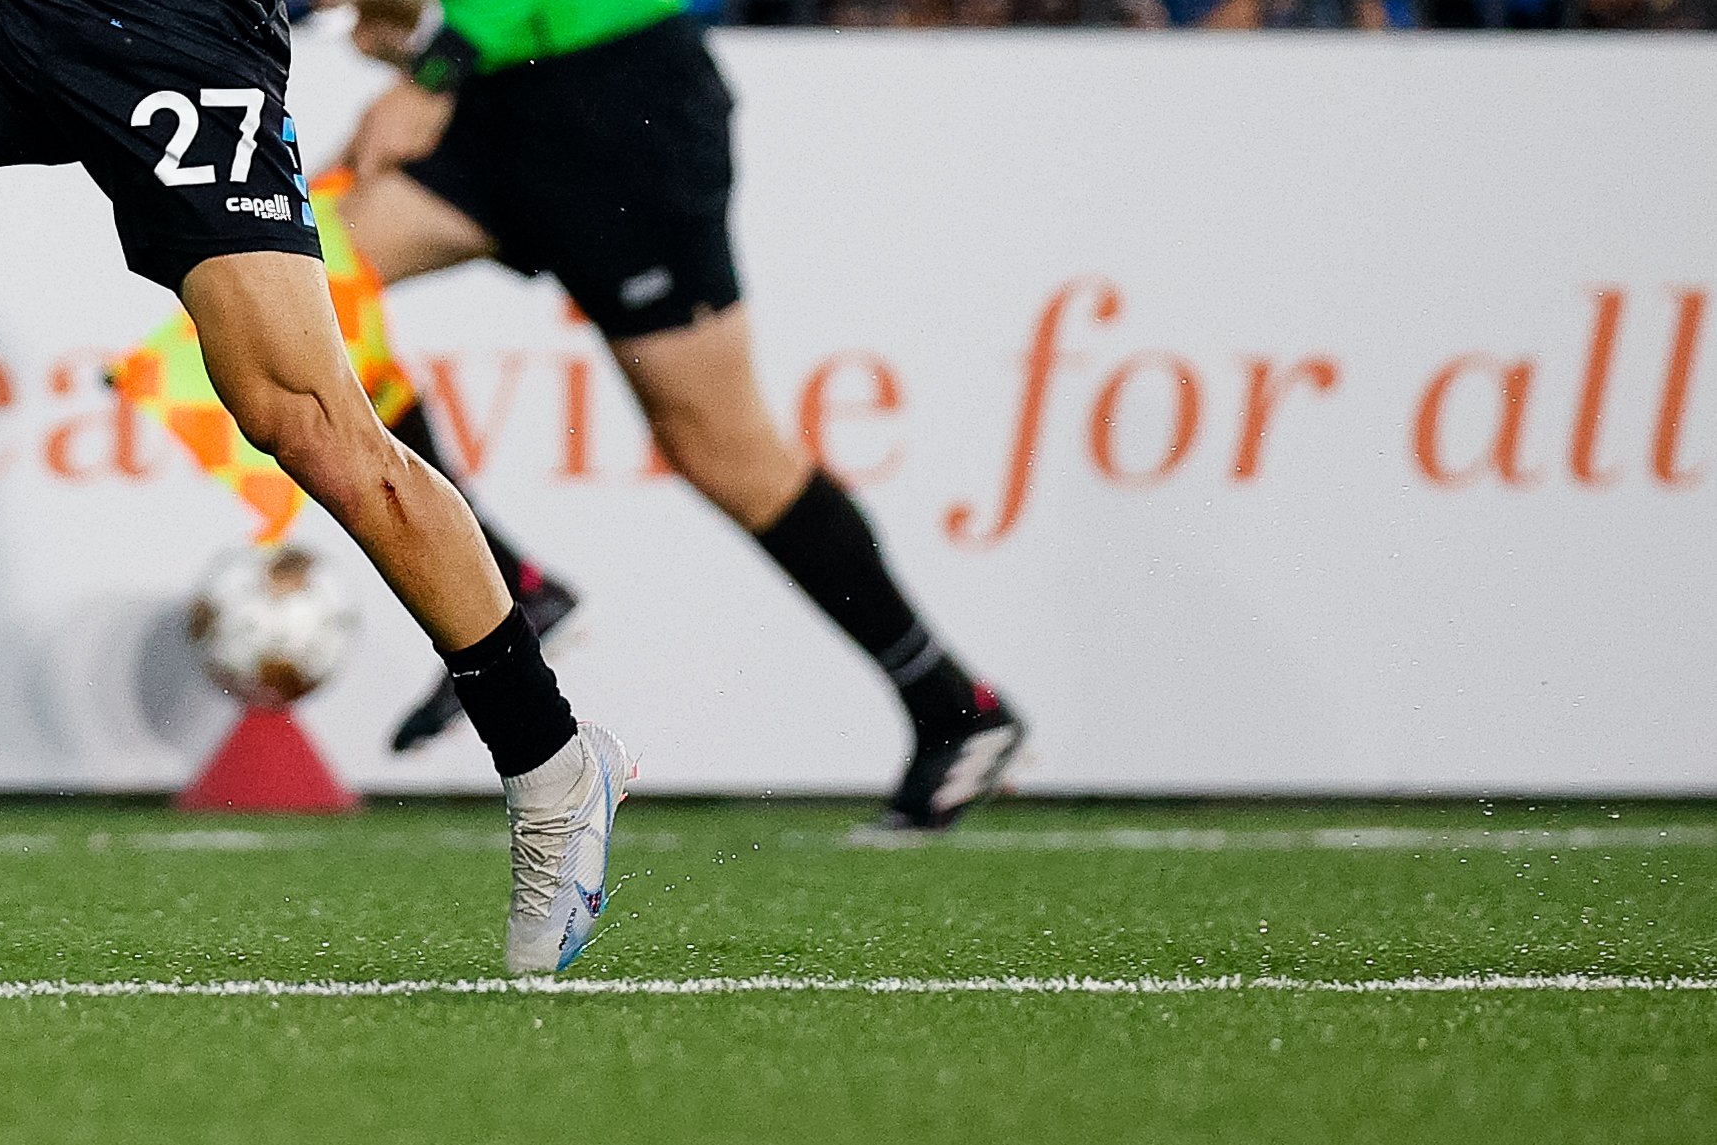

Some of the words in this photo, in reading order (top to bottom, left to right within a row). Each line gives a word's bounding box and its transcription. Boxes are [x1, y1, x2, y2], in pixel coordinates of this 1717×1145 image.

[131, 88, 265, 187] 27
[225, 194, 291, 217] capelli
[418, 294, 908, 490] vie
[941, 272, 1340, 555] for
[1410, 282, 1710, 494] all
